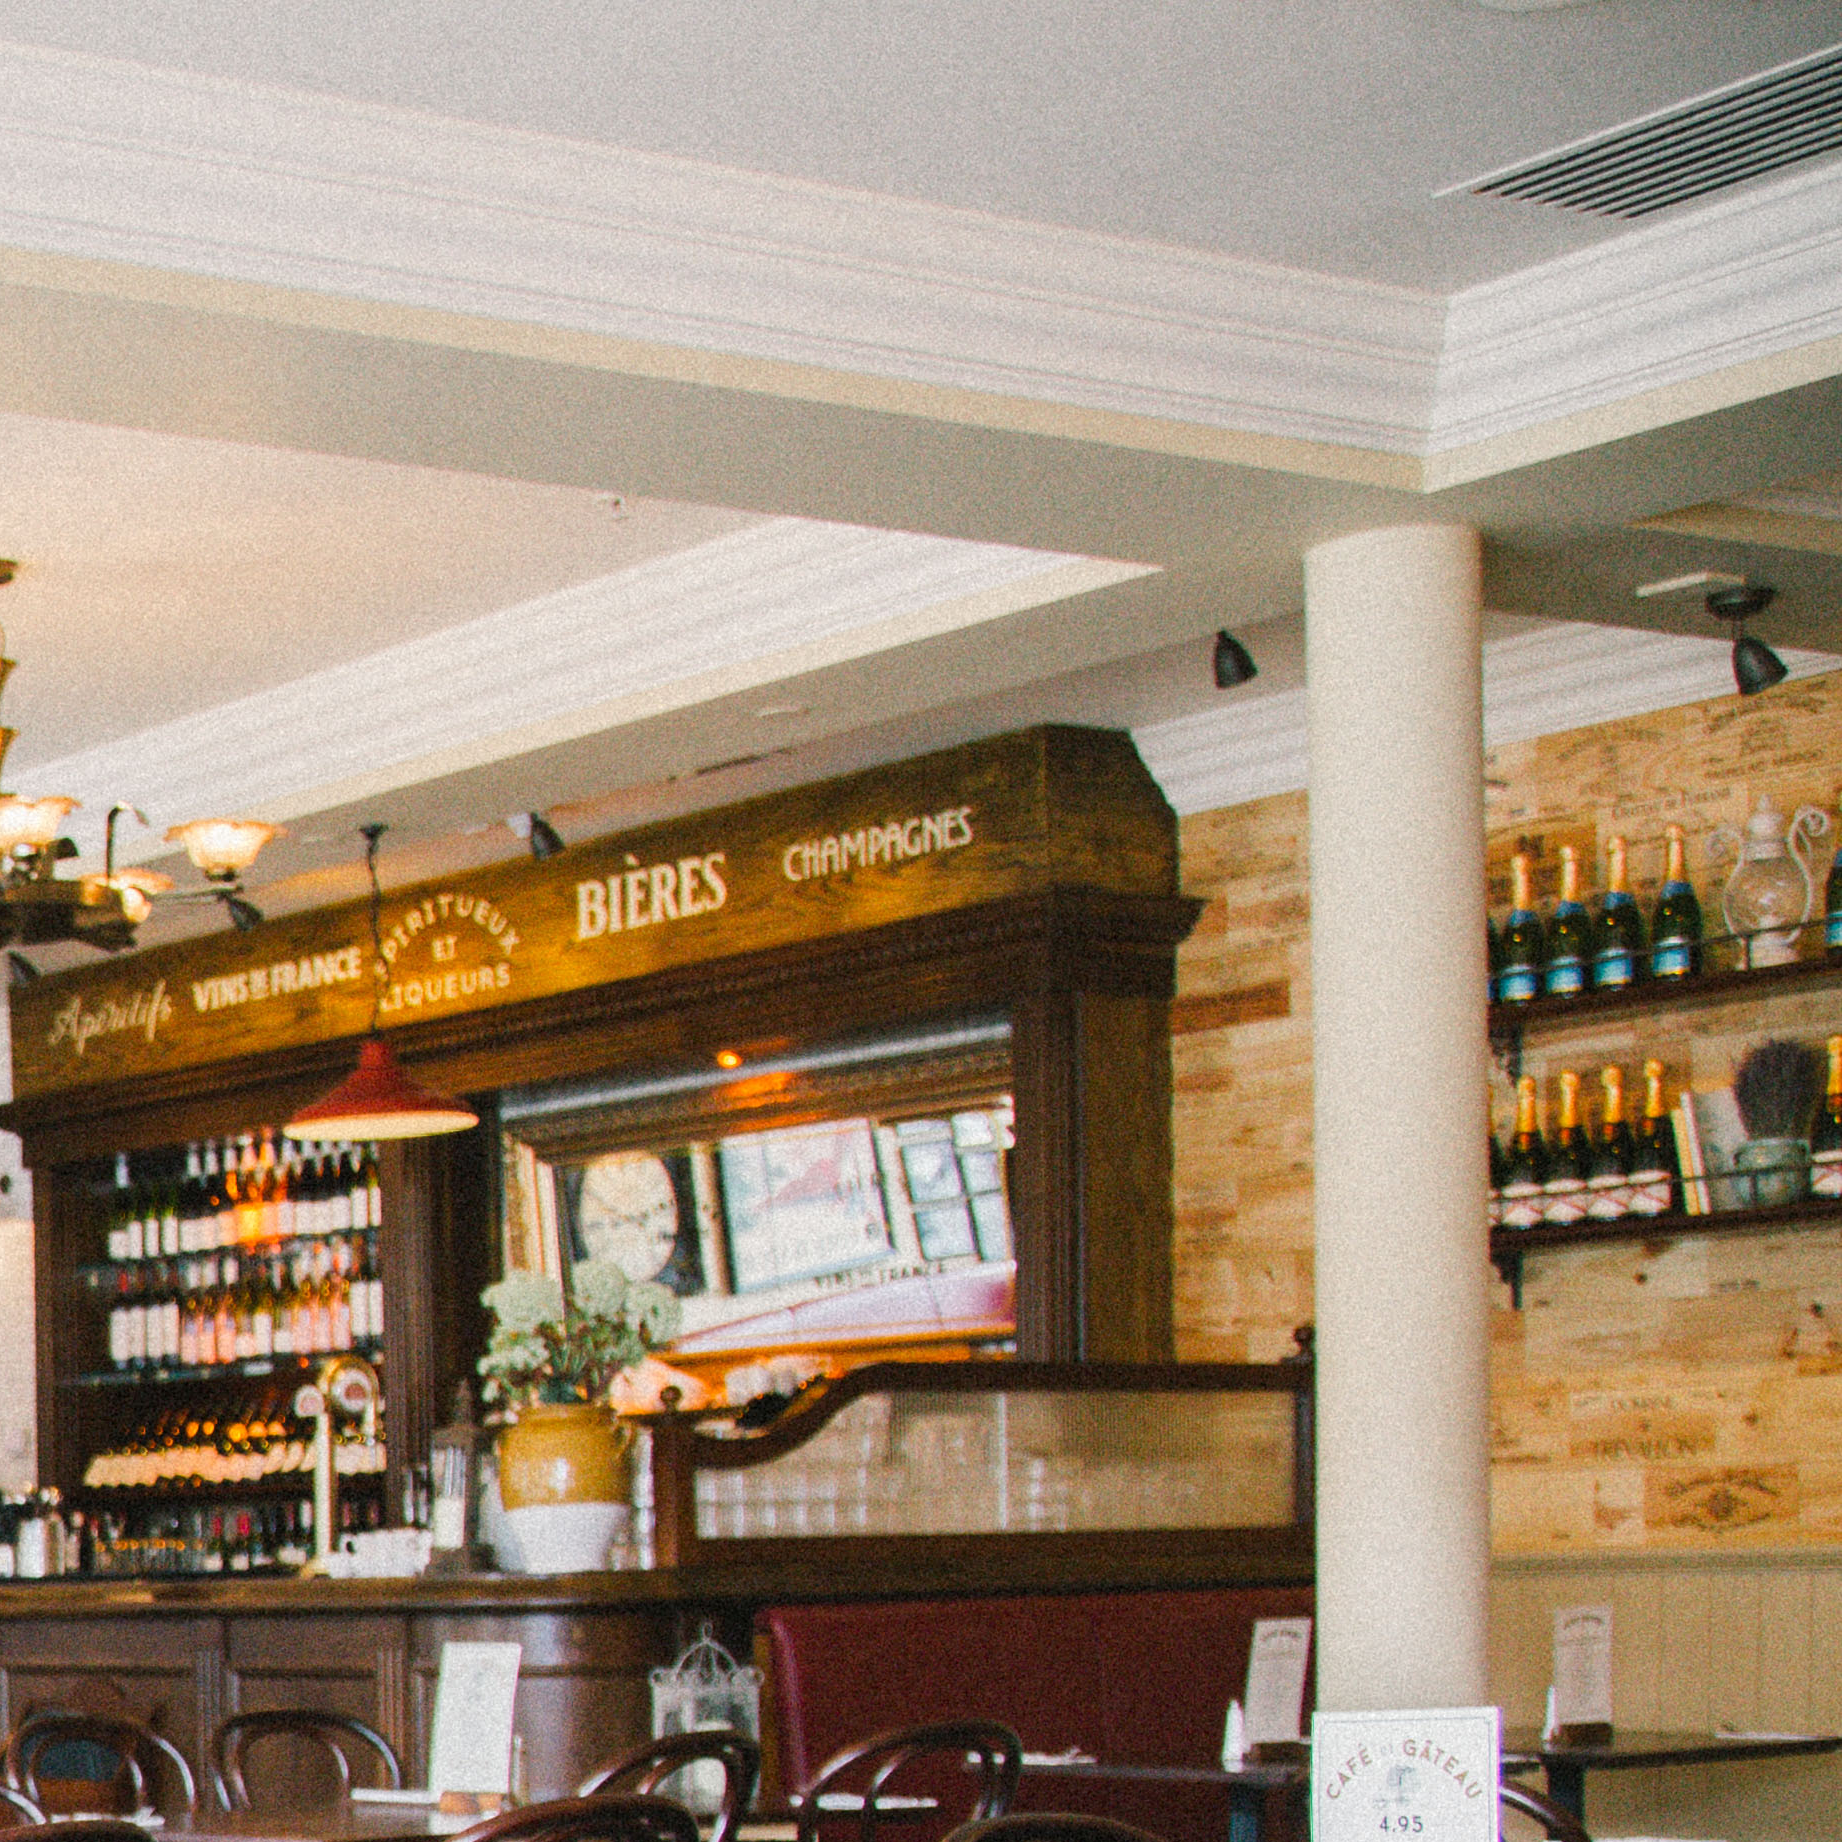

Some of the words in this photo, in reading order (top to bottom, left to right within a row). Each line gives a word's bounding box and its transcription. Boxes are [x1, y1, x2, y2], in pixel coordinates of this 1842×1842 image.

[782, 805, 974, 882] CHAMPAGNES
[576, 852, 728, 942] BIÈRES
[431, 935, 458, 961] ET
[192, 972, 249, 1013] VINS
[270, 945, 362, 997] FRANCE
[380, 961, 511, 1013] LIQUEURS
[1326, 1743, 1373, 1800] CAFÉ
[1403, 1739, 1484, 1799] GÂTEAU
[1379, 1815, 1424, 1833] 4.95
